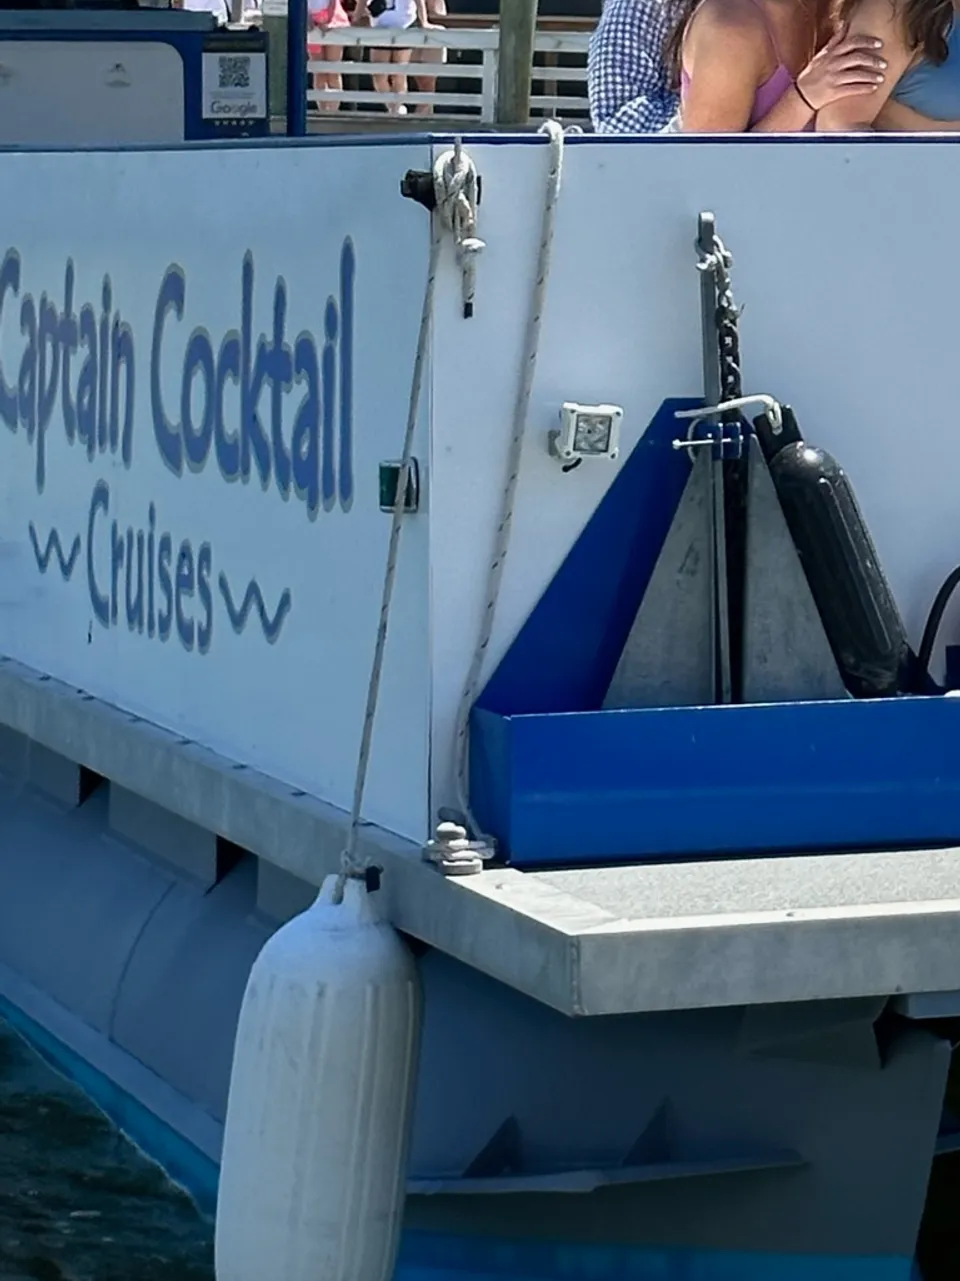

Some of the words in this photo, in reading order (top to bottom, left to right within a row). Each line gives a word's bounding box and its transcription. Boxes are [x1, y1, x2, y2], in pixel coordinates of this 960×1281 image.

[0, 246, 135, 495] Captain
[150, 234, 355, 522] Cocktail
[86, 478, 213, 655] Cruises
